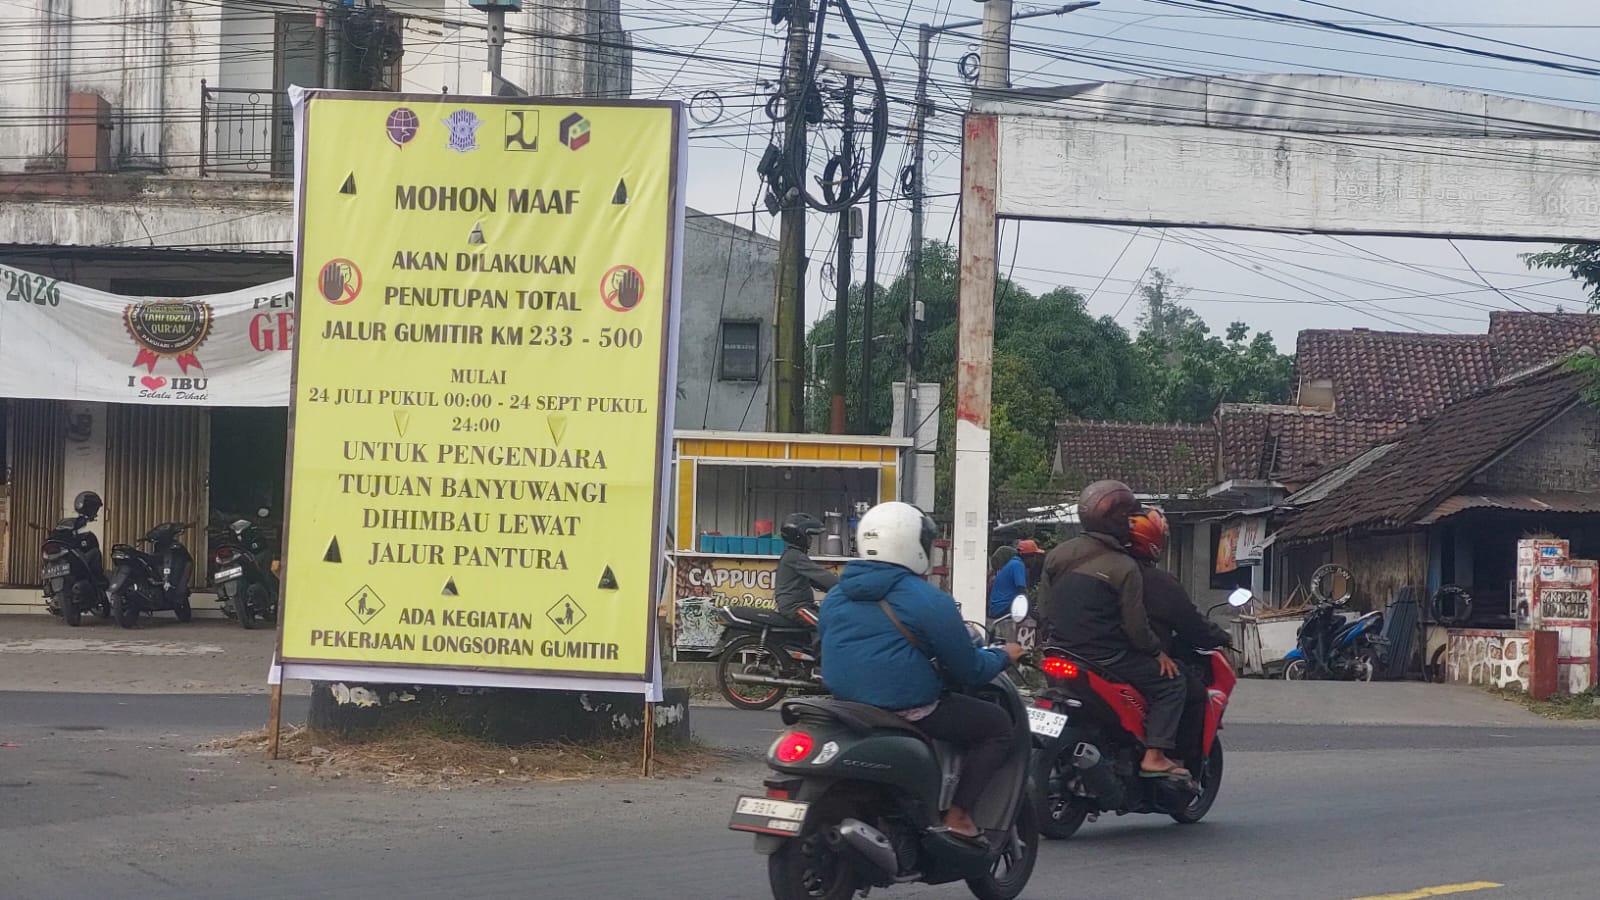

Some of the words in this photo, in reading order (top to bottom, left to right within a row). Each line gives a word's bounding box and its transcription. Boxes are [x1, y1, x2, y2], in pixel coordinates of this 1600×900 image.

[395, 184, 497, 213] MOHON
[508, 188, 580, 215] MAAF
[391, 250, 448, 272] AKAN
[455, 252, 577, 275] DILAKUKAN
[0, 268, 61, 307] 2026
[384, 286, 509, 310] PENUTUPAN
[515, 290, 583, 312] TOTAL
[321, 320, 387, 342] JALUR
[394, 322, 484, 345] GUMITIR
[491, 325, 524, 346] KM
[528, 324, 573, 347] 233
[598, 327, 643, 349] 500
[171, 377, 208, 391] IBU
[450, 368, 507, 385] MULAI
[138, 389, 171, 399] Selalu
[175, 391, 208, 401] Dihati
[308, 387, 330, 403] 24
[334, 388, 373, 406] JULI
[378, 389, 439, 407] PUKUL
[443, 392, 492, 409] 00:00
[509, 394, 531, 410] 24
[536, 395, 582, 412] SEPT
[587, 397, 648, 414] PUKUL
[451, 416, 501, 433] 24:00
[343, 440, 429, 463] UNTUK
[436, 443, 608, 470] PENGENDARA
[338, 473, 433, 498] TUJUAN
[440, 477, 607, 504] BANYUWANGI
[362, 508, 490, 533] DIHIMBAU
[498, 513, 581, 537] LEWAT
[367, 542, 445, 566] JALUR
[452, 545, 569, 571] PANTURA
[713, 591, 739, 608] The
[398, 607, 436, 626] ADA
[442, 609, 533, 630] KEGIATAN
[310, 629, 416, 651] PEKERJAAN
[421, 634, 534, 657] LONGSORAN
[540, 639, 619, 661] GUMITIR
